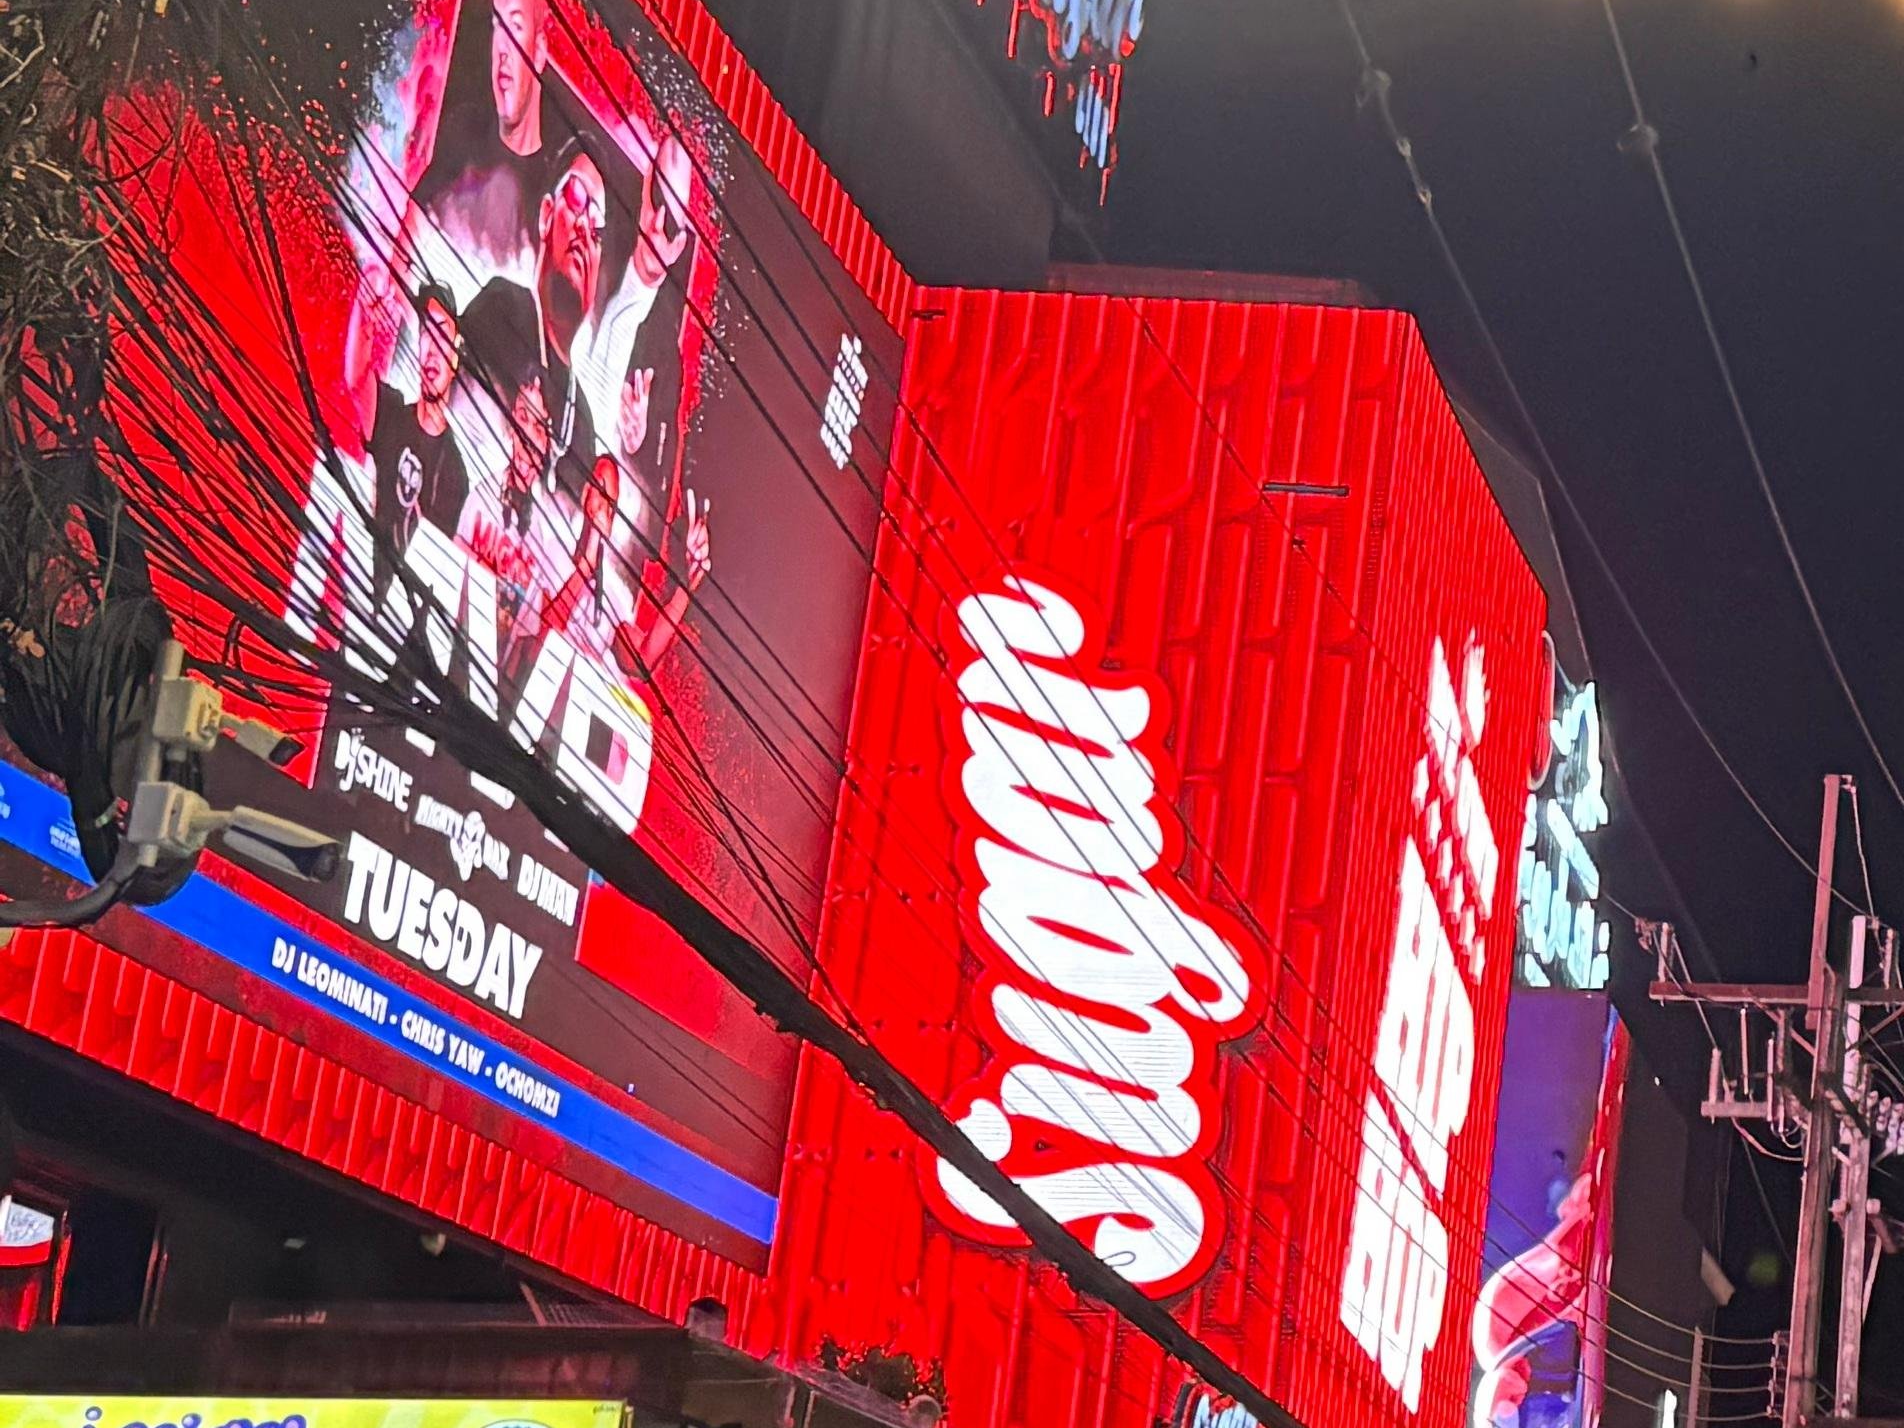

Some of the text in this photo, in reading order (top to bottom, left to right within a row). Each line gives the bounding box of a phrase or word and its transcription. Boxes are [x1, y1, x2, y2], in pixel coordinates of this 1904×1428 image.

[271, 936, 296, 973] DJ
[297, 952, 389, 1025] LEOMINATI
[401, 1009, 446, 1056] CHRIS
[449, 1032, 486, 1076] YAW
[344, 829, 543, 1020] TUESDAY
[937, 574, 1252, 1287] Sugar
